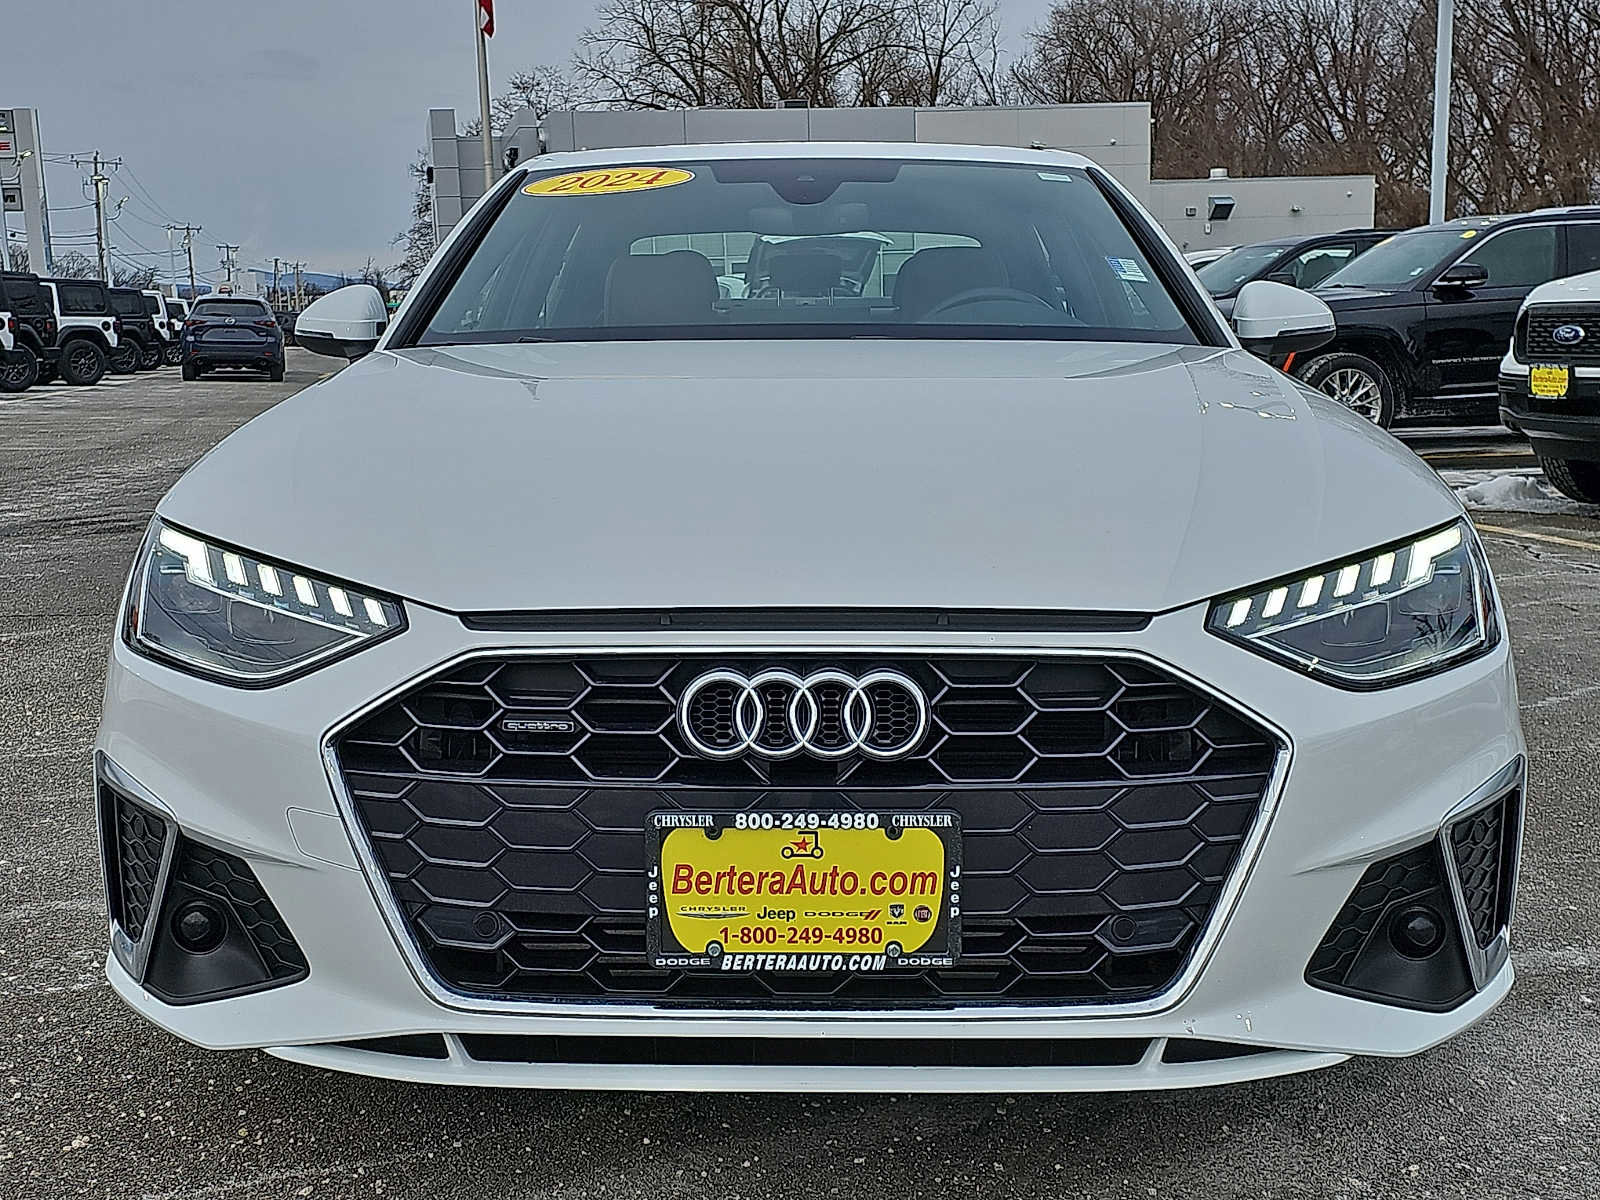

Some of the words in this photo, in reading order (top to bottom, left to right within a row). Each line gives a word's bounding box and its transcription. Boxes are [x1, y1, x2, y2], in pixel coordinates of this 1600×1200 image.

[548, 171, 668, 193] 2024
[507, 722, 569, 731] quattro
[653, 814, 714, 827] CHRYSLER
[735, 813, 879, 829] 800-249-4980
[891, 814, 953, 827] CHRYSLER
[672, 864, 938, 896] BerteraAuto.com
[647, 865, 659, 919] Jeep
[949, 865, 961, 918] Jeep
[757, 906, 796, 922] Jeep
[719, 926, 883, 944] 1-800-249-4980
[655, 958, 711, 966] DODGE
[721, 954, 887, 971] BERTERAAUTO.COM
[897, 957, 953, 966] DODGE
